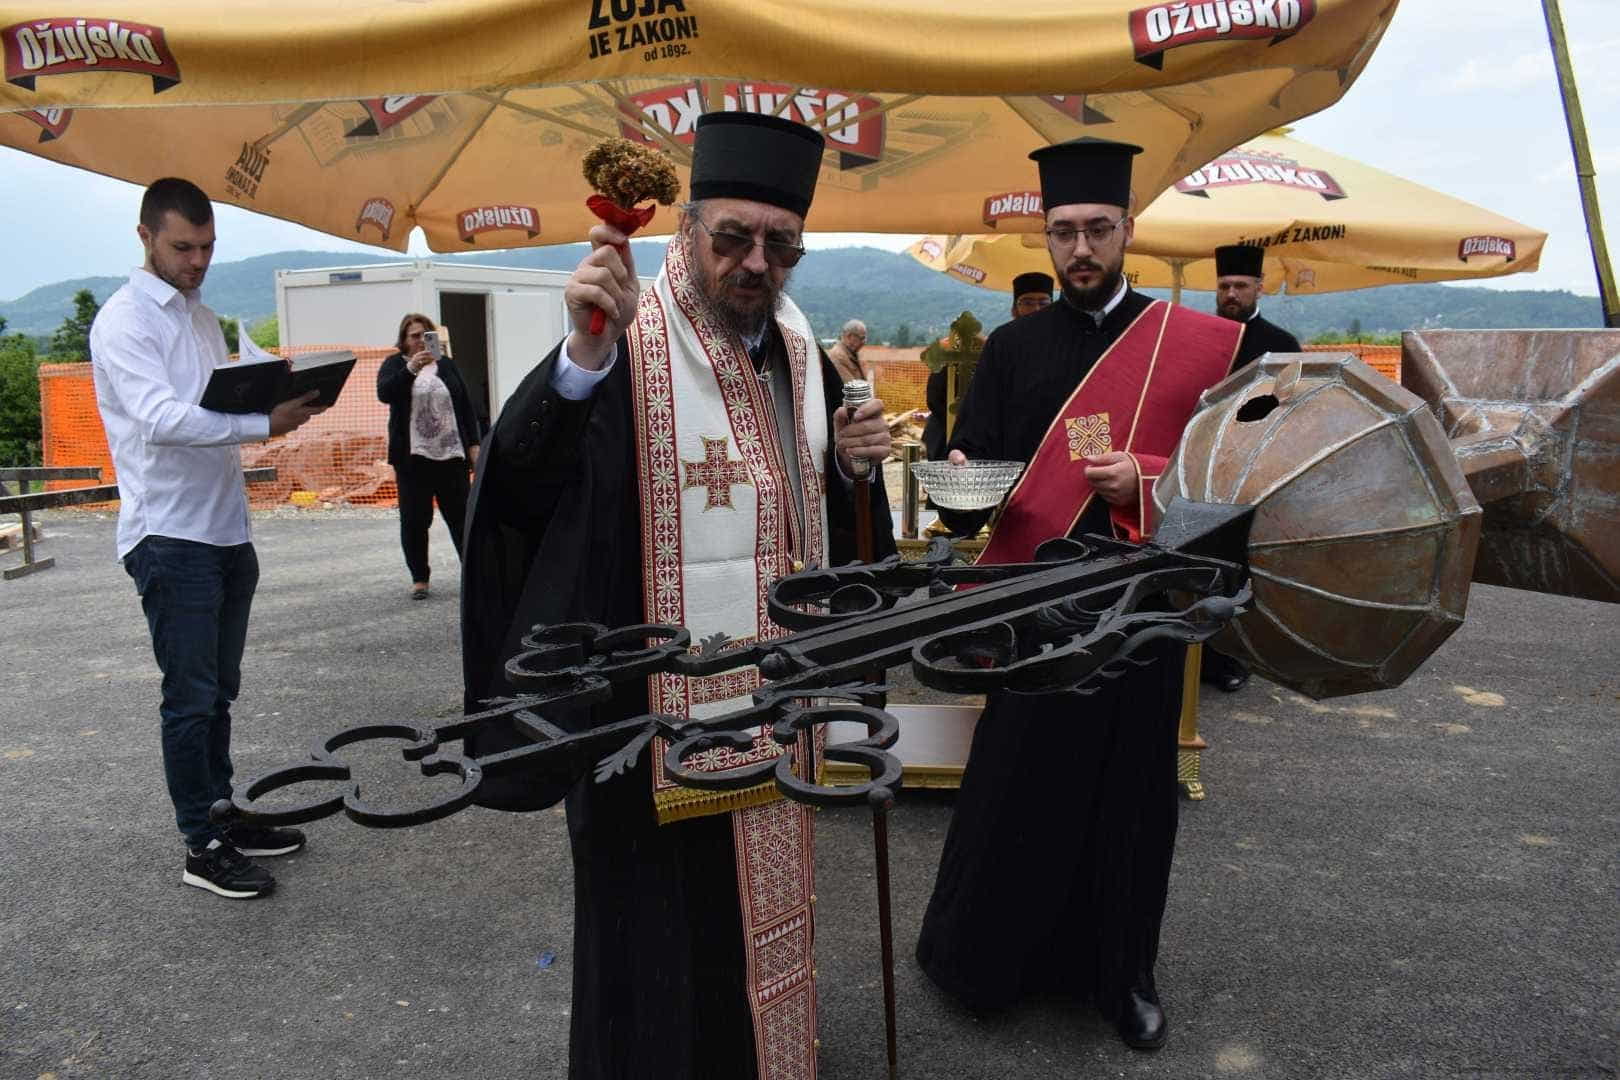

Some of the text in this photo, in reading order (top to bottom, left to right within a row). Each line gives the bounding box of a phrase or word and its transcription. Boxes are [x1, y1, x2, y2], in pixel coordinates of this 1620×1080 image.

[589, 16, 699, 59] JE ZAKON!
[1145, 0, 1301, 42] Ožujsko
[16, 20, 162, 70] Ožujsko
[644, 44, 691, 61] od 1892.
[1292, 224, 1346, 243] ZAKON!
